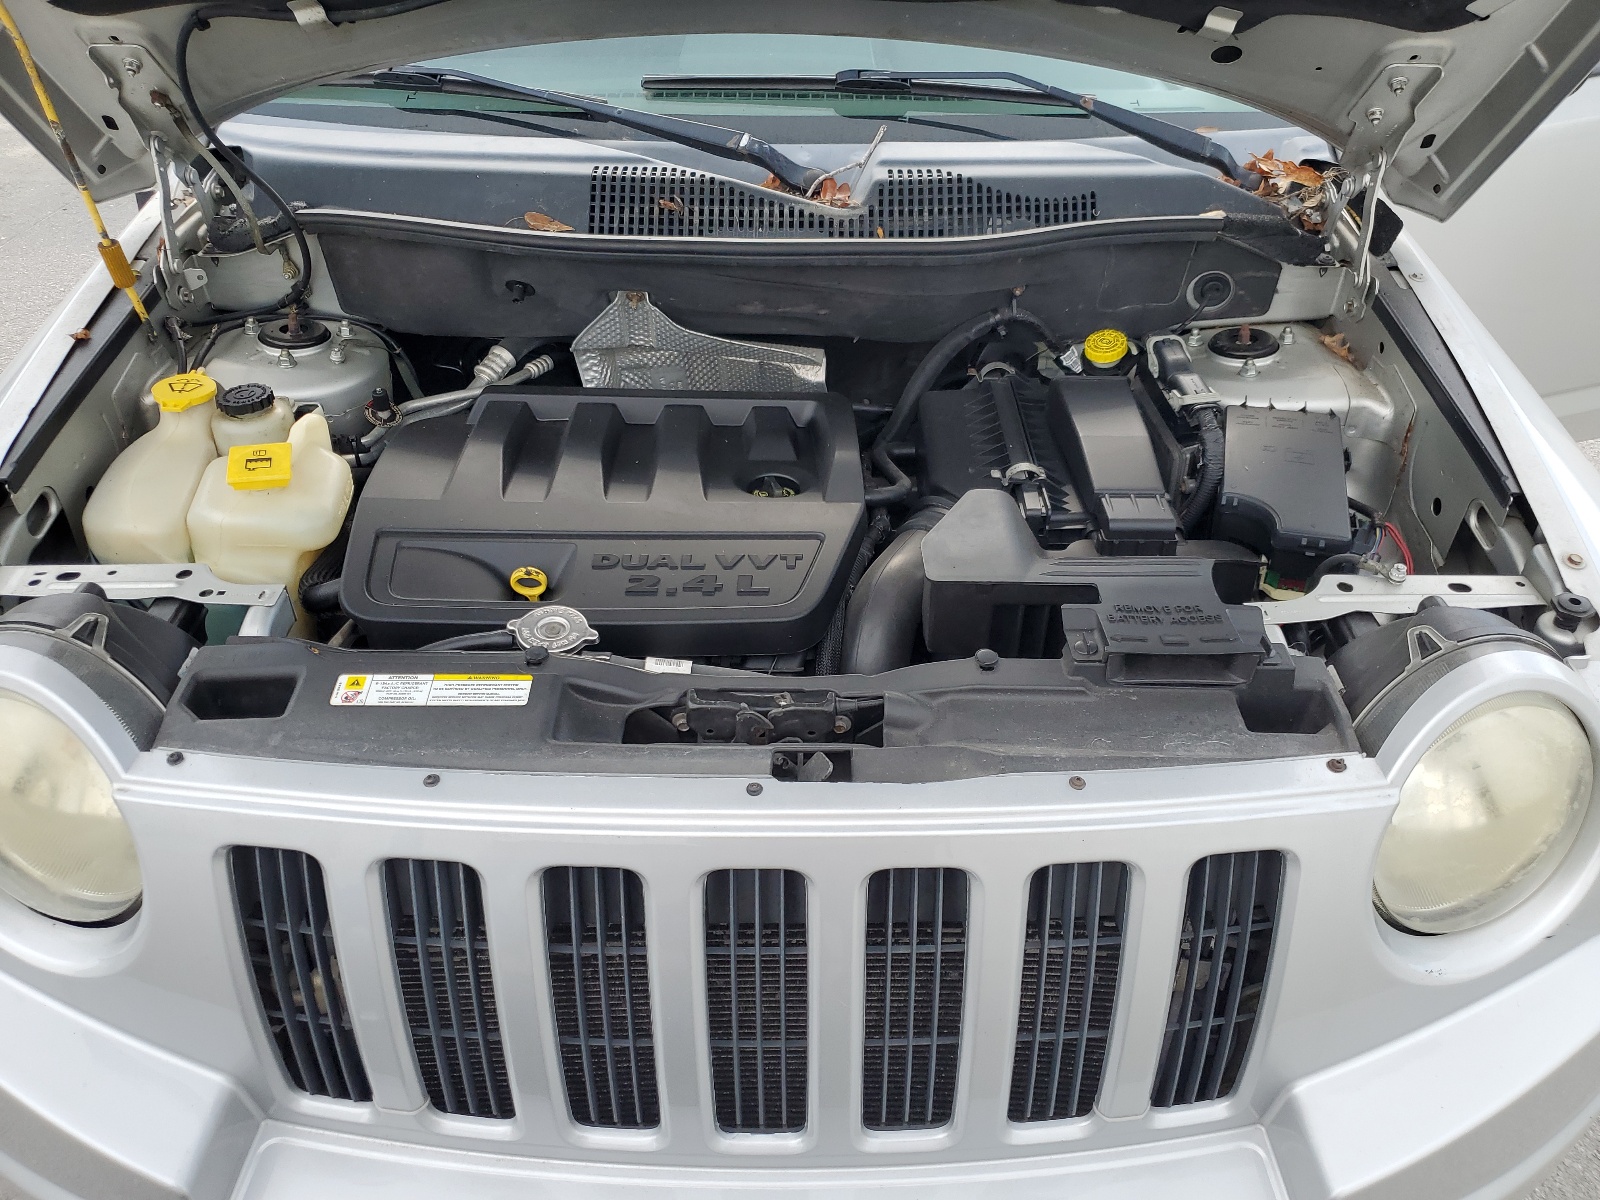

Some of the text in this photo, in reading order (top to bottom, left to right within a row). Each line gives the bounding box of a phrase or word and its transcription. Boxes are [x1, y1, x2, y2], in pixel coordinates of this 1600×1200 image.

[591, 553, 804, 570] DUAL VVT
[1113, 604, 1204, 614] REMOVE FOR
[1106, 613, 1224, 625] BATTERY ACCESS
